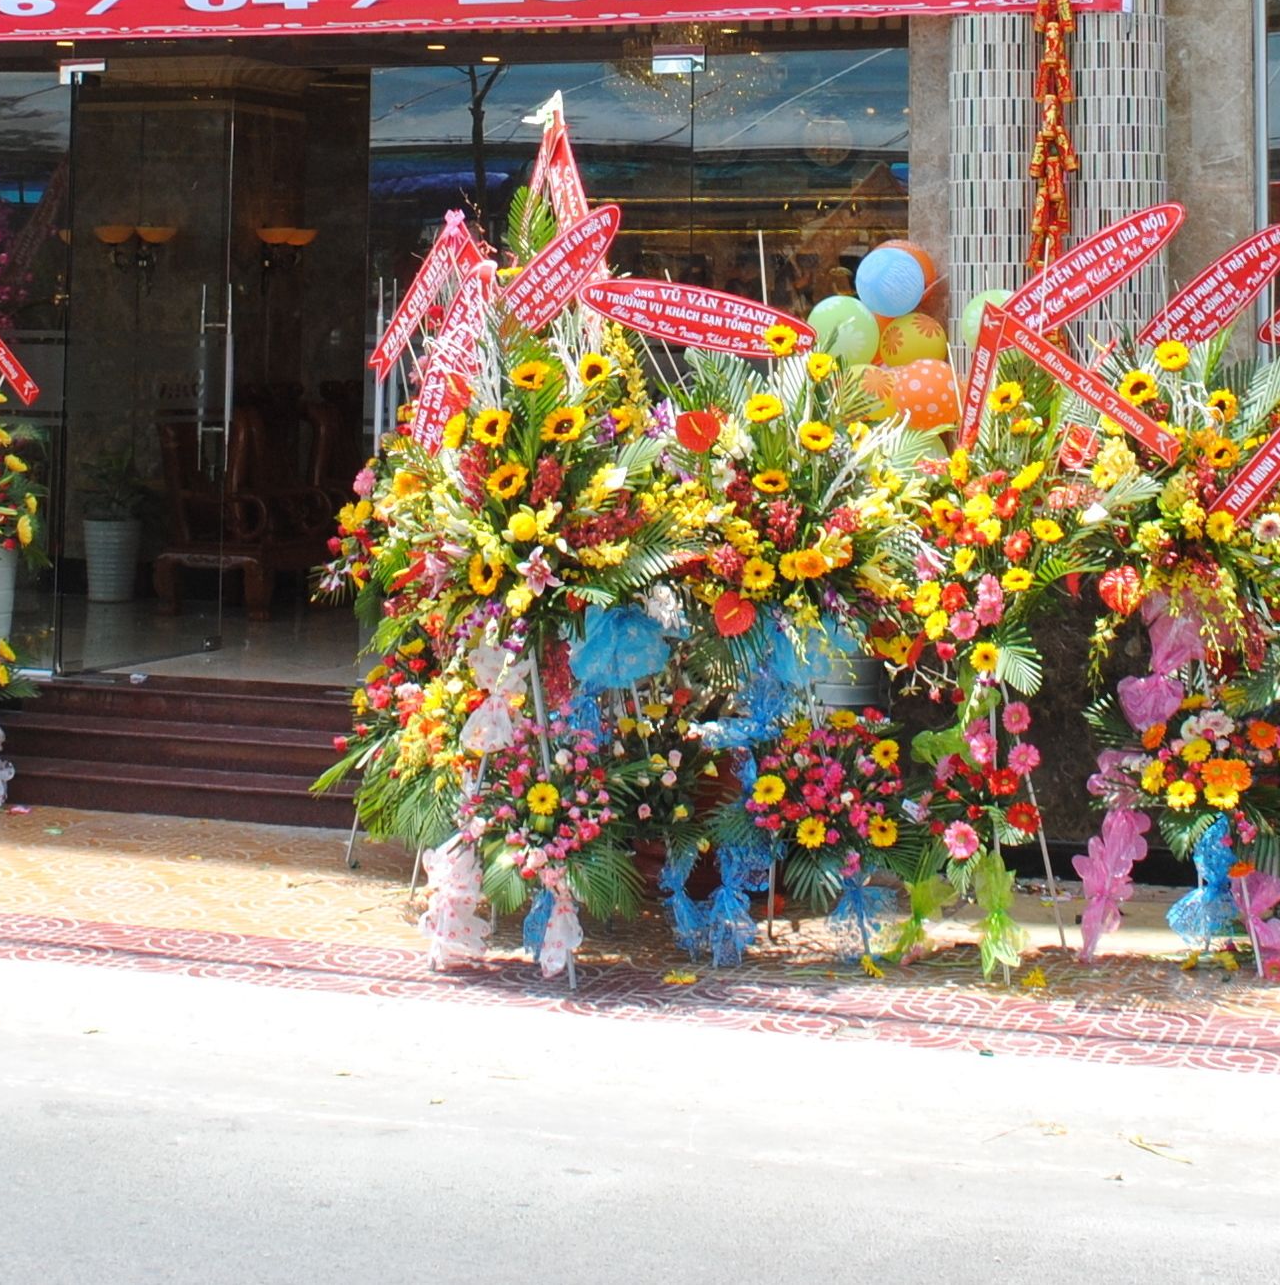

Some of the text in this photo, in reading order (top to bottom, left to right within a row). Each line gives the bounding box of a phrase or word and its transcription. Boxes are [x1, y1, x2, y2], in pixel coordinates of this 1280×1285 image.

[1030, 211, 1169, 304] NGUYỄN VĂN LIN (HÀ NỘI)
[588, 287, 603, 303] VỤ
[648, 300, 664, 316] VỤ
[665, 304, 700, 321] KHÁCH
[702, 313, 724, 329] SẠN
[633, 286, 776, 325] ÔNG VŨ VĂN THANH
[1168, 306, 1185, 323] TRA
[1190, 280, 1236, 324] BỘ CÔNG AN
[380, 310, 411, 356] PHAN
[1013, 329, 1146, 435] Chúc Mừng Khai Trương
[1248, 455, 1276, 485] MINH
